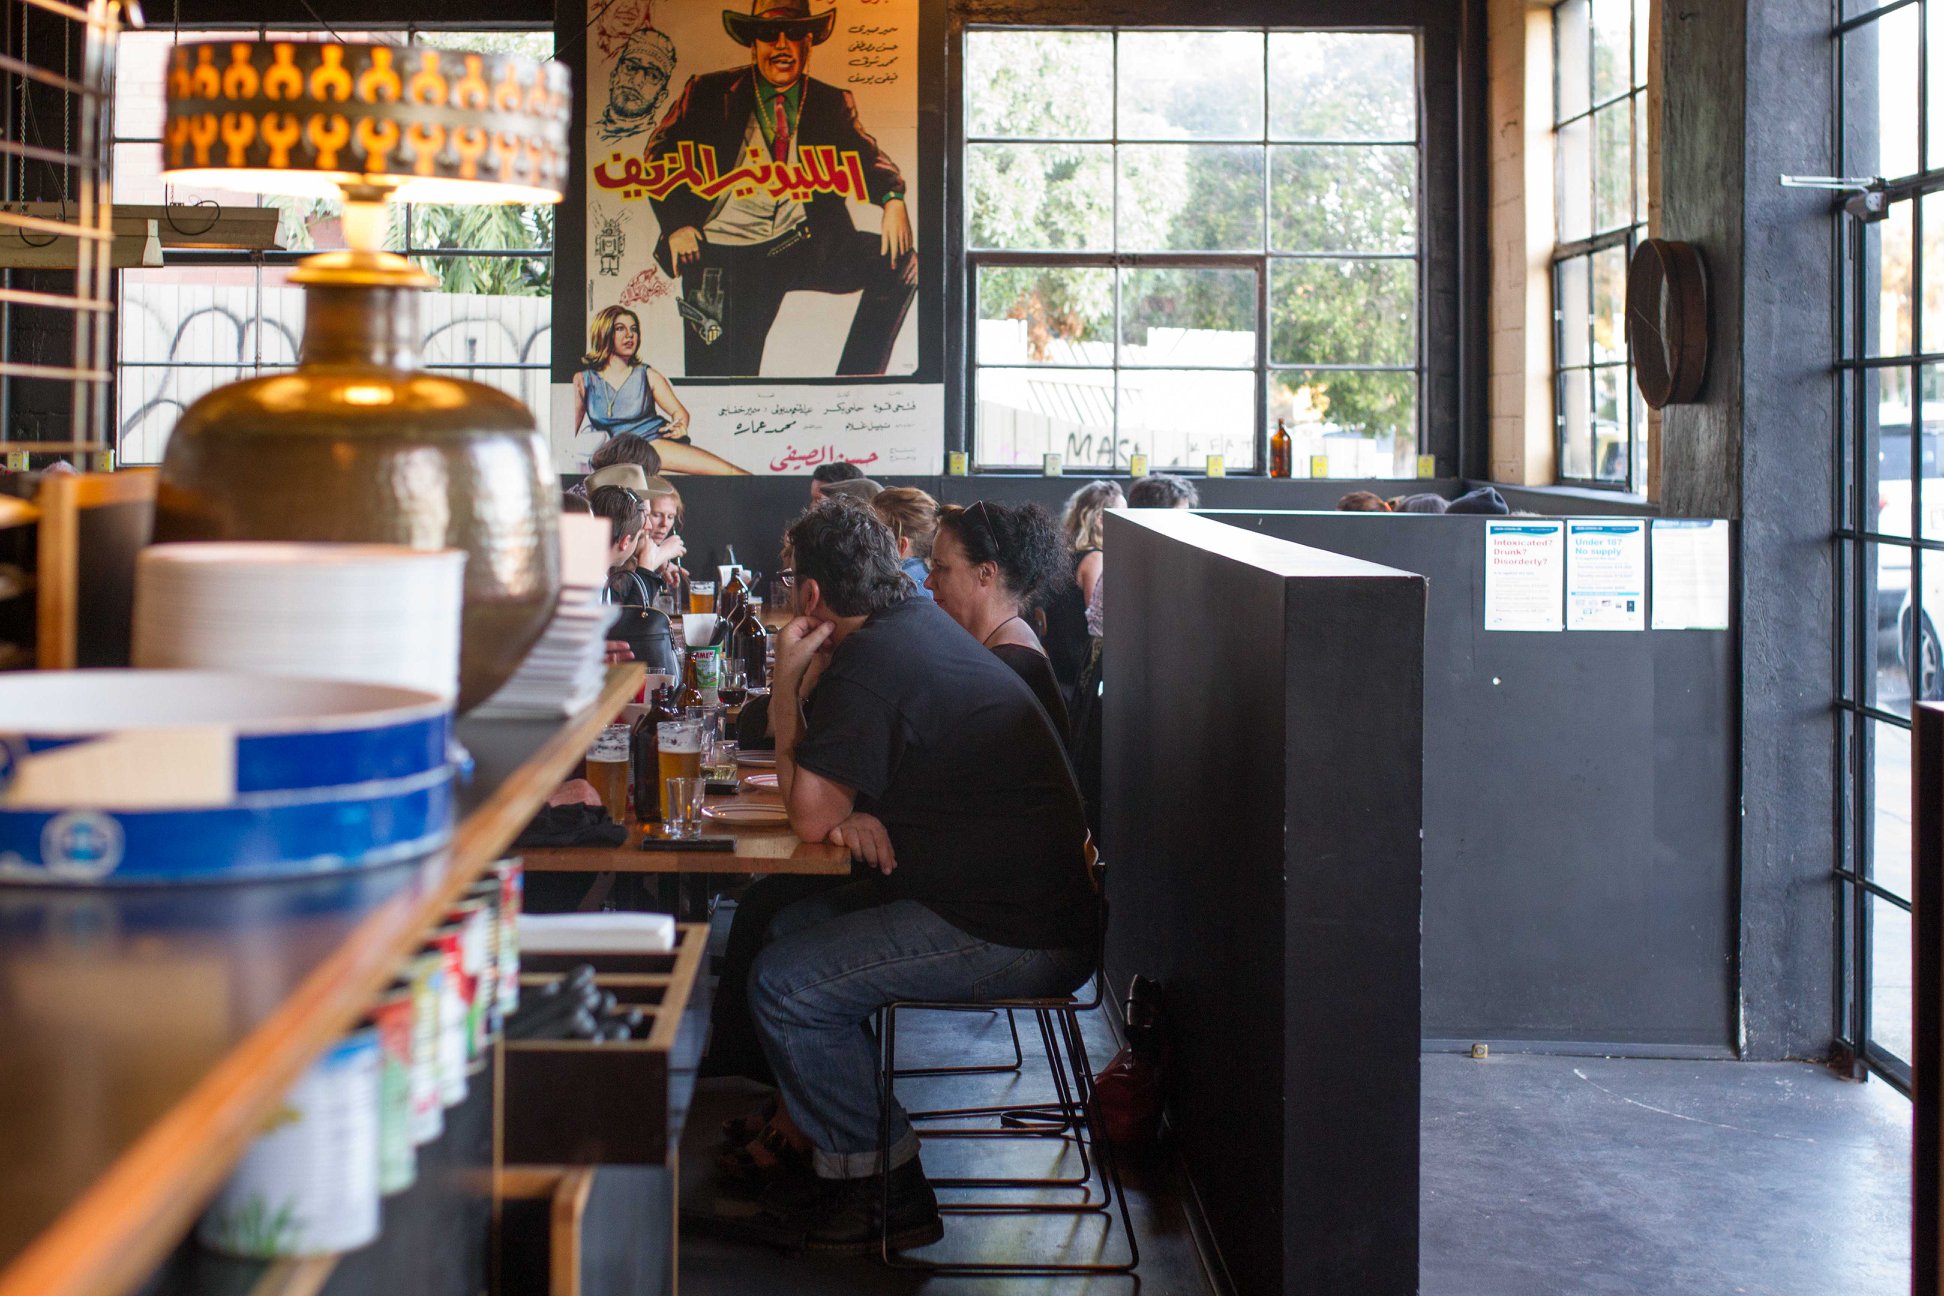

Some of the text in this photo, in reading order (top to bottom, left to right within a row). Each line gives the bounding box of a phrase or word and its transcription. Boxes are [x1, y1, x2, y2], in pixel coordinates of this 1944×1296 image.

[593, 140, 870, 203] المليونير المزيف
[765, 420, 797, 434] محمد
[1575, 538, 1604, 546] Under
[1575, 547, 1622, 556] No supply
[1493, 557, 1548, 567] Disorderly?
